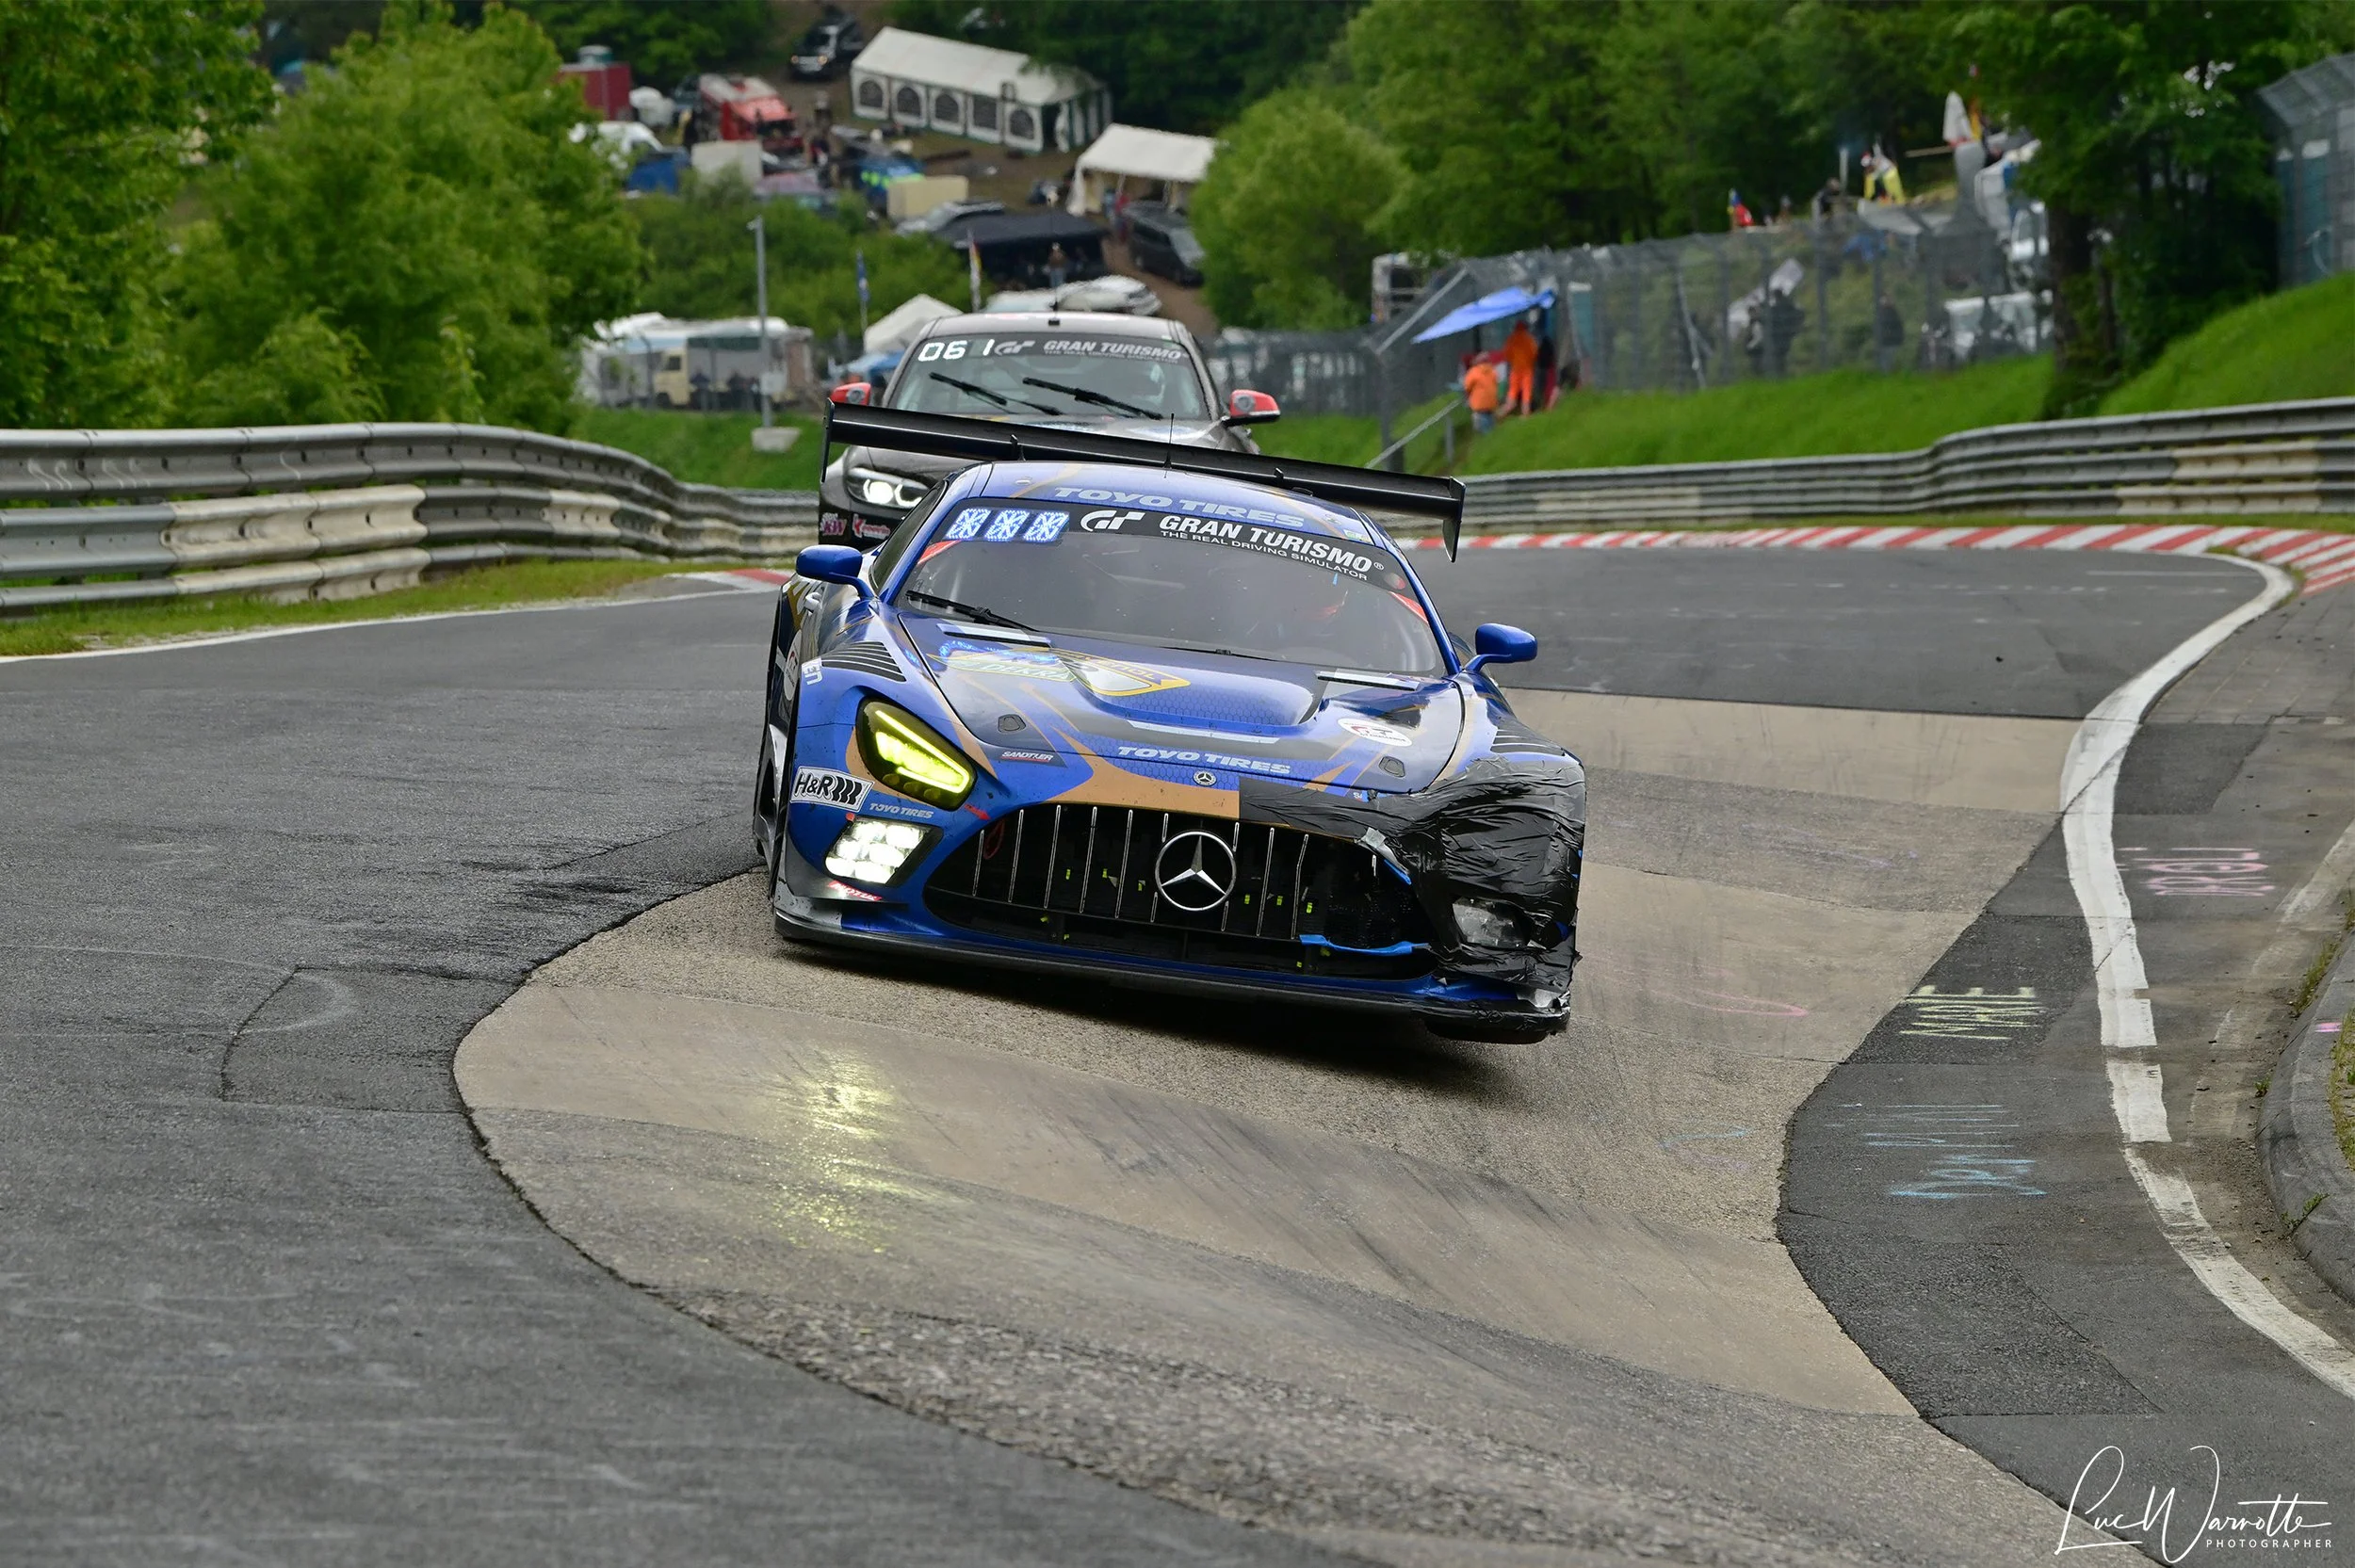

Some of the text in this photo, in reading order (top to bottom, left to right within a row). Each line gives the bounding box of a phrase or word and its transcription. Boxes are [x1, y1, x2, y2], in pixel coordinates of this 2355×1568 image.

[1043, 340, 1096, 352] GRAN
[1054, 487, 1305, 527] TOYO TIRES
[1159, 515, 1242, 540] GRAN
[1161, 530, 1368, 581] THE REAL DRIVING SIMULATOR
[1118, 747, 1291, 774] TOYO TIRES
[794, 772, 835, 799] H&R
[900, 808, 934, 818] TIRES
